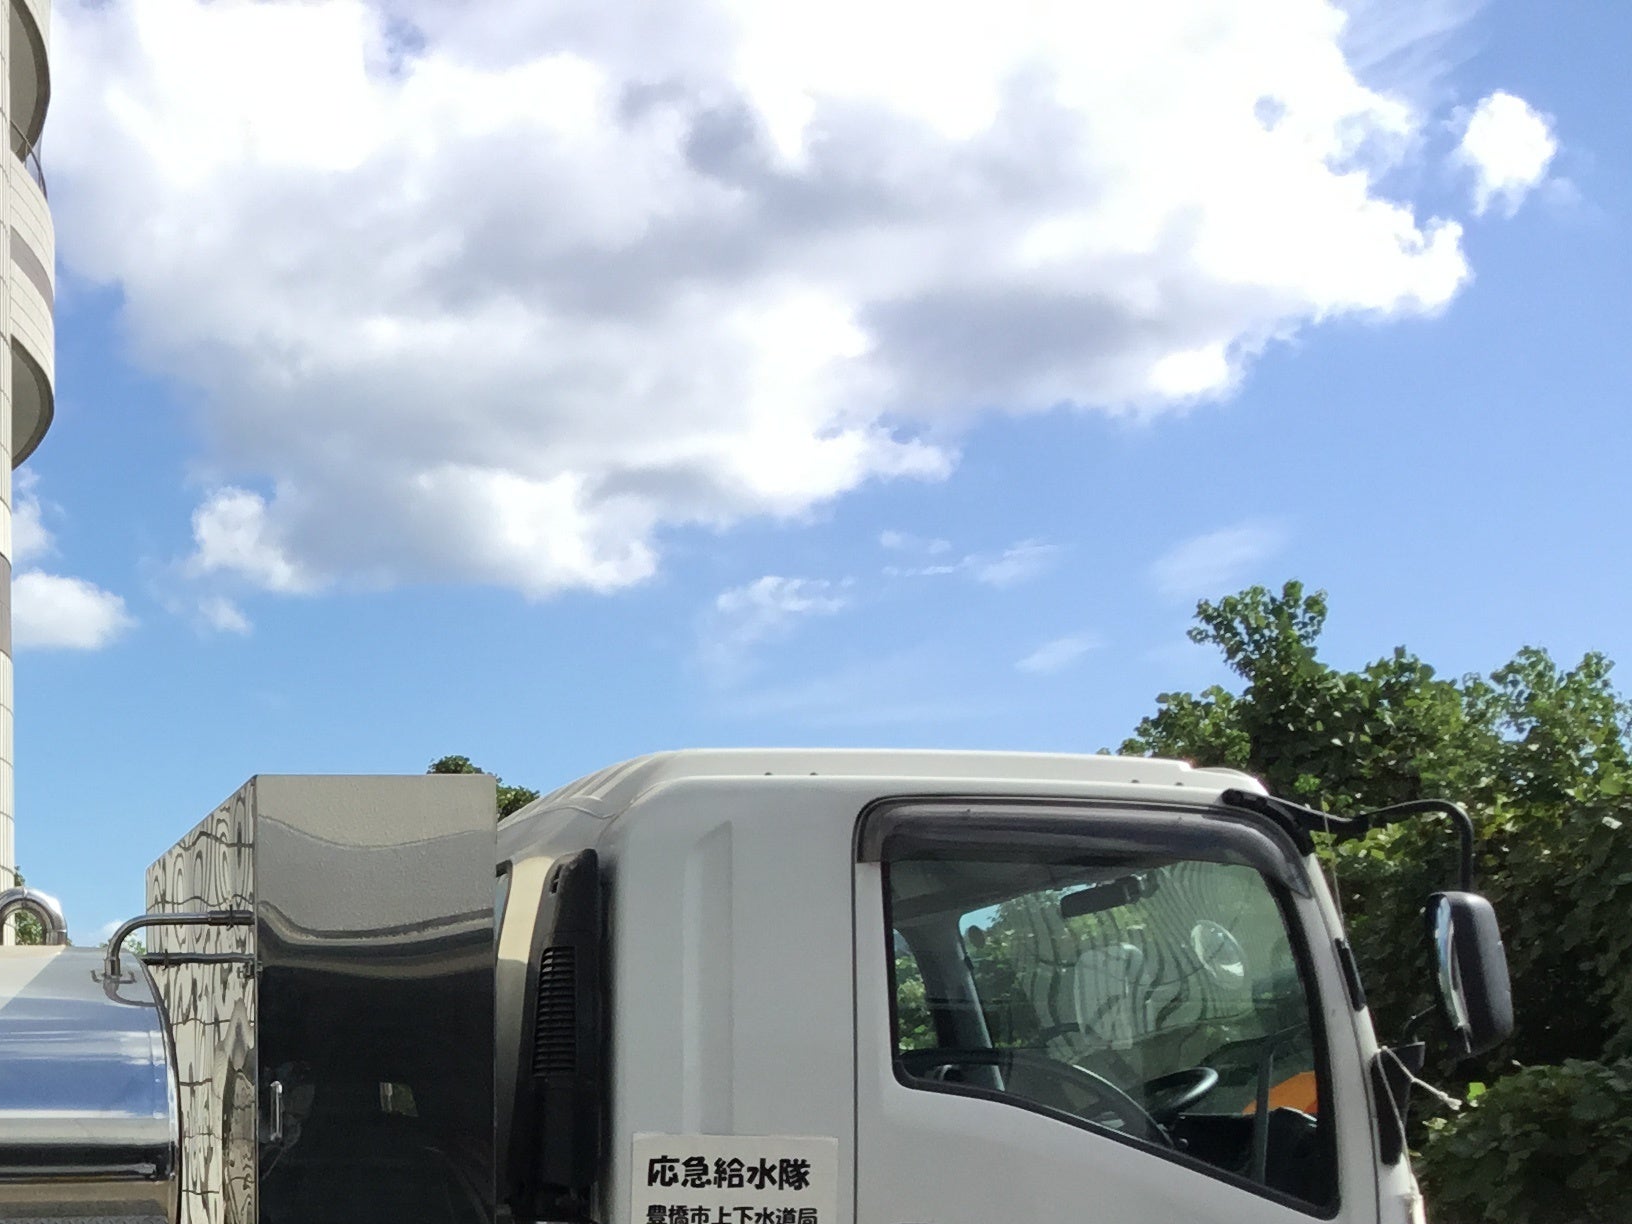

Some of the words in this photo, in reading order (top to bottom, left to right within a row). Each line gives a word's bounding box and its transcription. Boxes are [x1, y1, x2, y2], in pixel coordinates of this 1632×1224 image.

[646, 1155, 811, 1191] 応急給水隊
